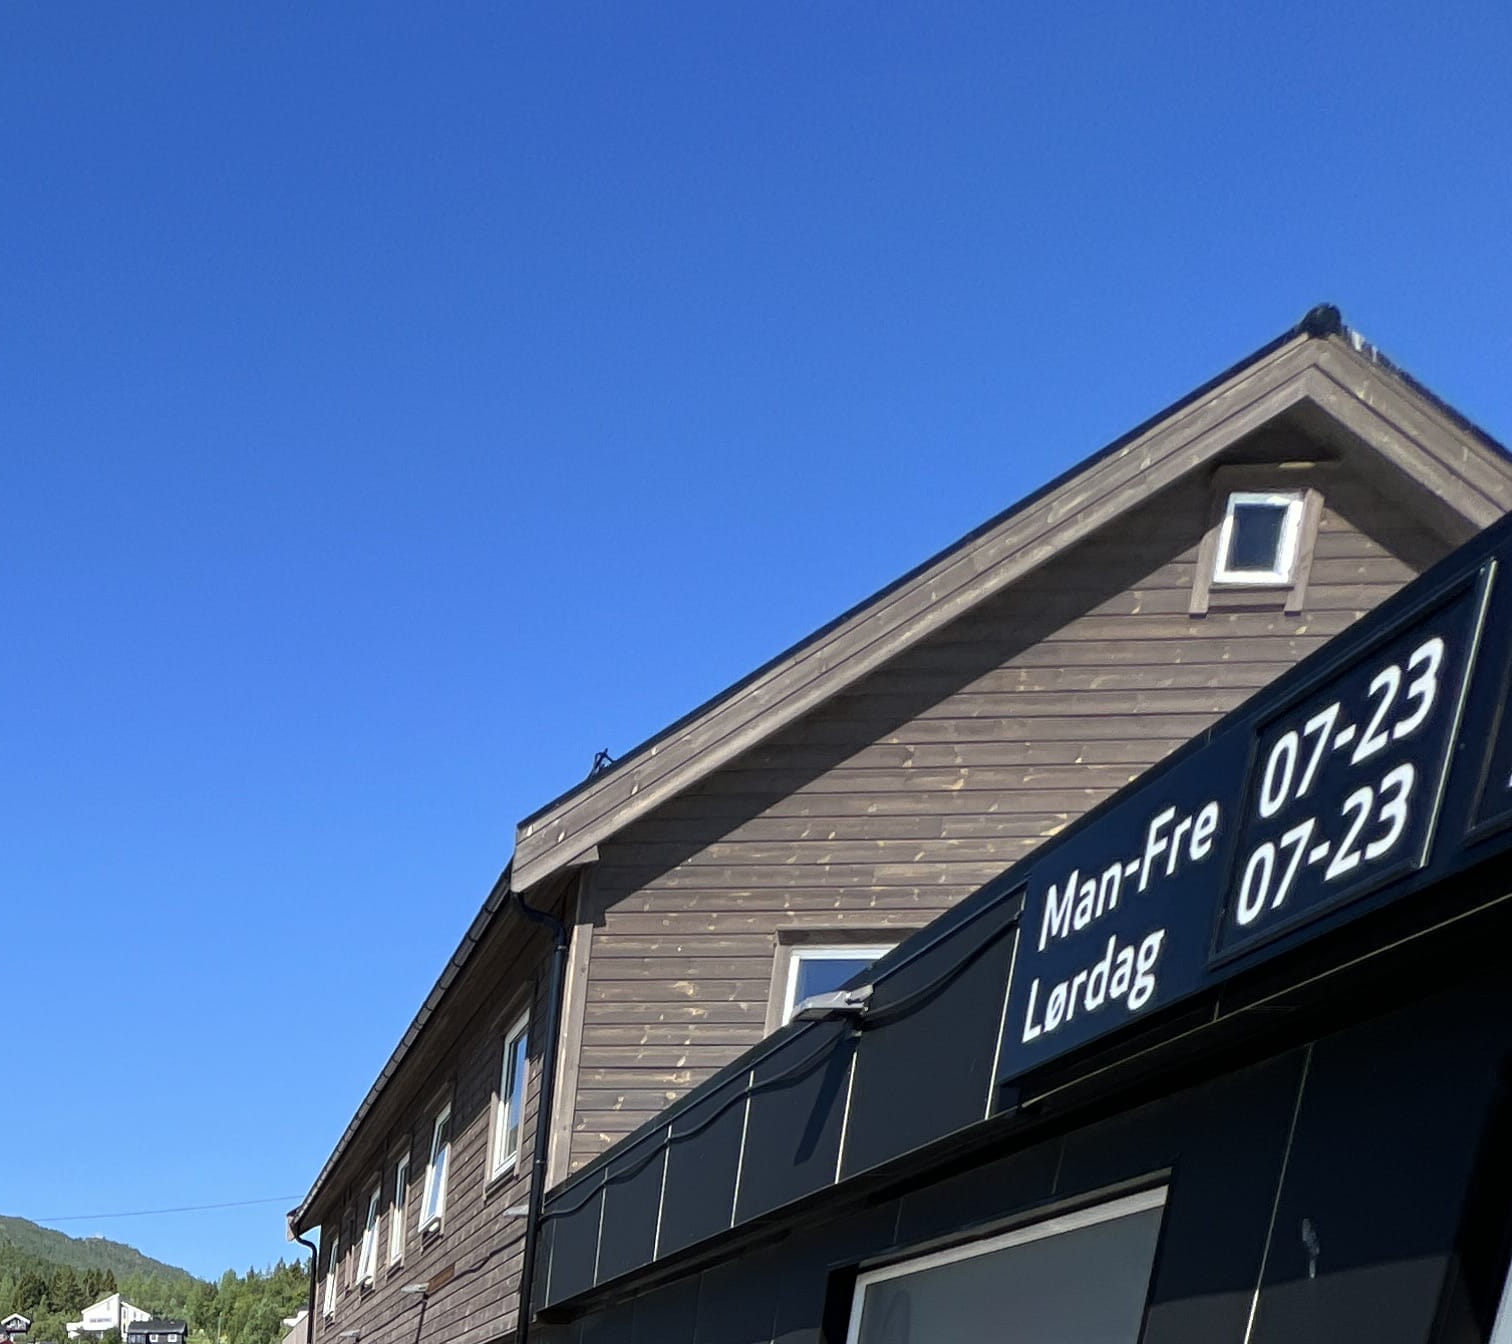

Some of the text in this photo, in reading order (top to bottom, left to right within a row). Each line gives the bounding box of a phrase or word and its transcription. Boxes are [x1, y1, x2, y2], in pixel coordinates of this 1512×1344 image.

[1021, 762, 1416, 1043] Lørdag 07-23
[1039, 637, 1445, 951] Man-Fre 07-23
